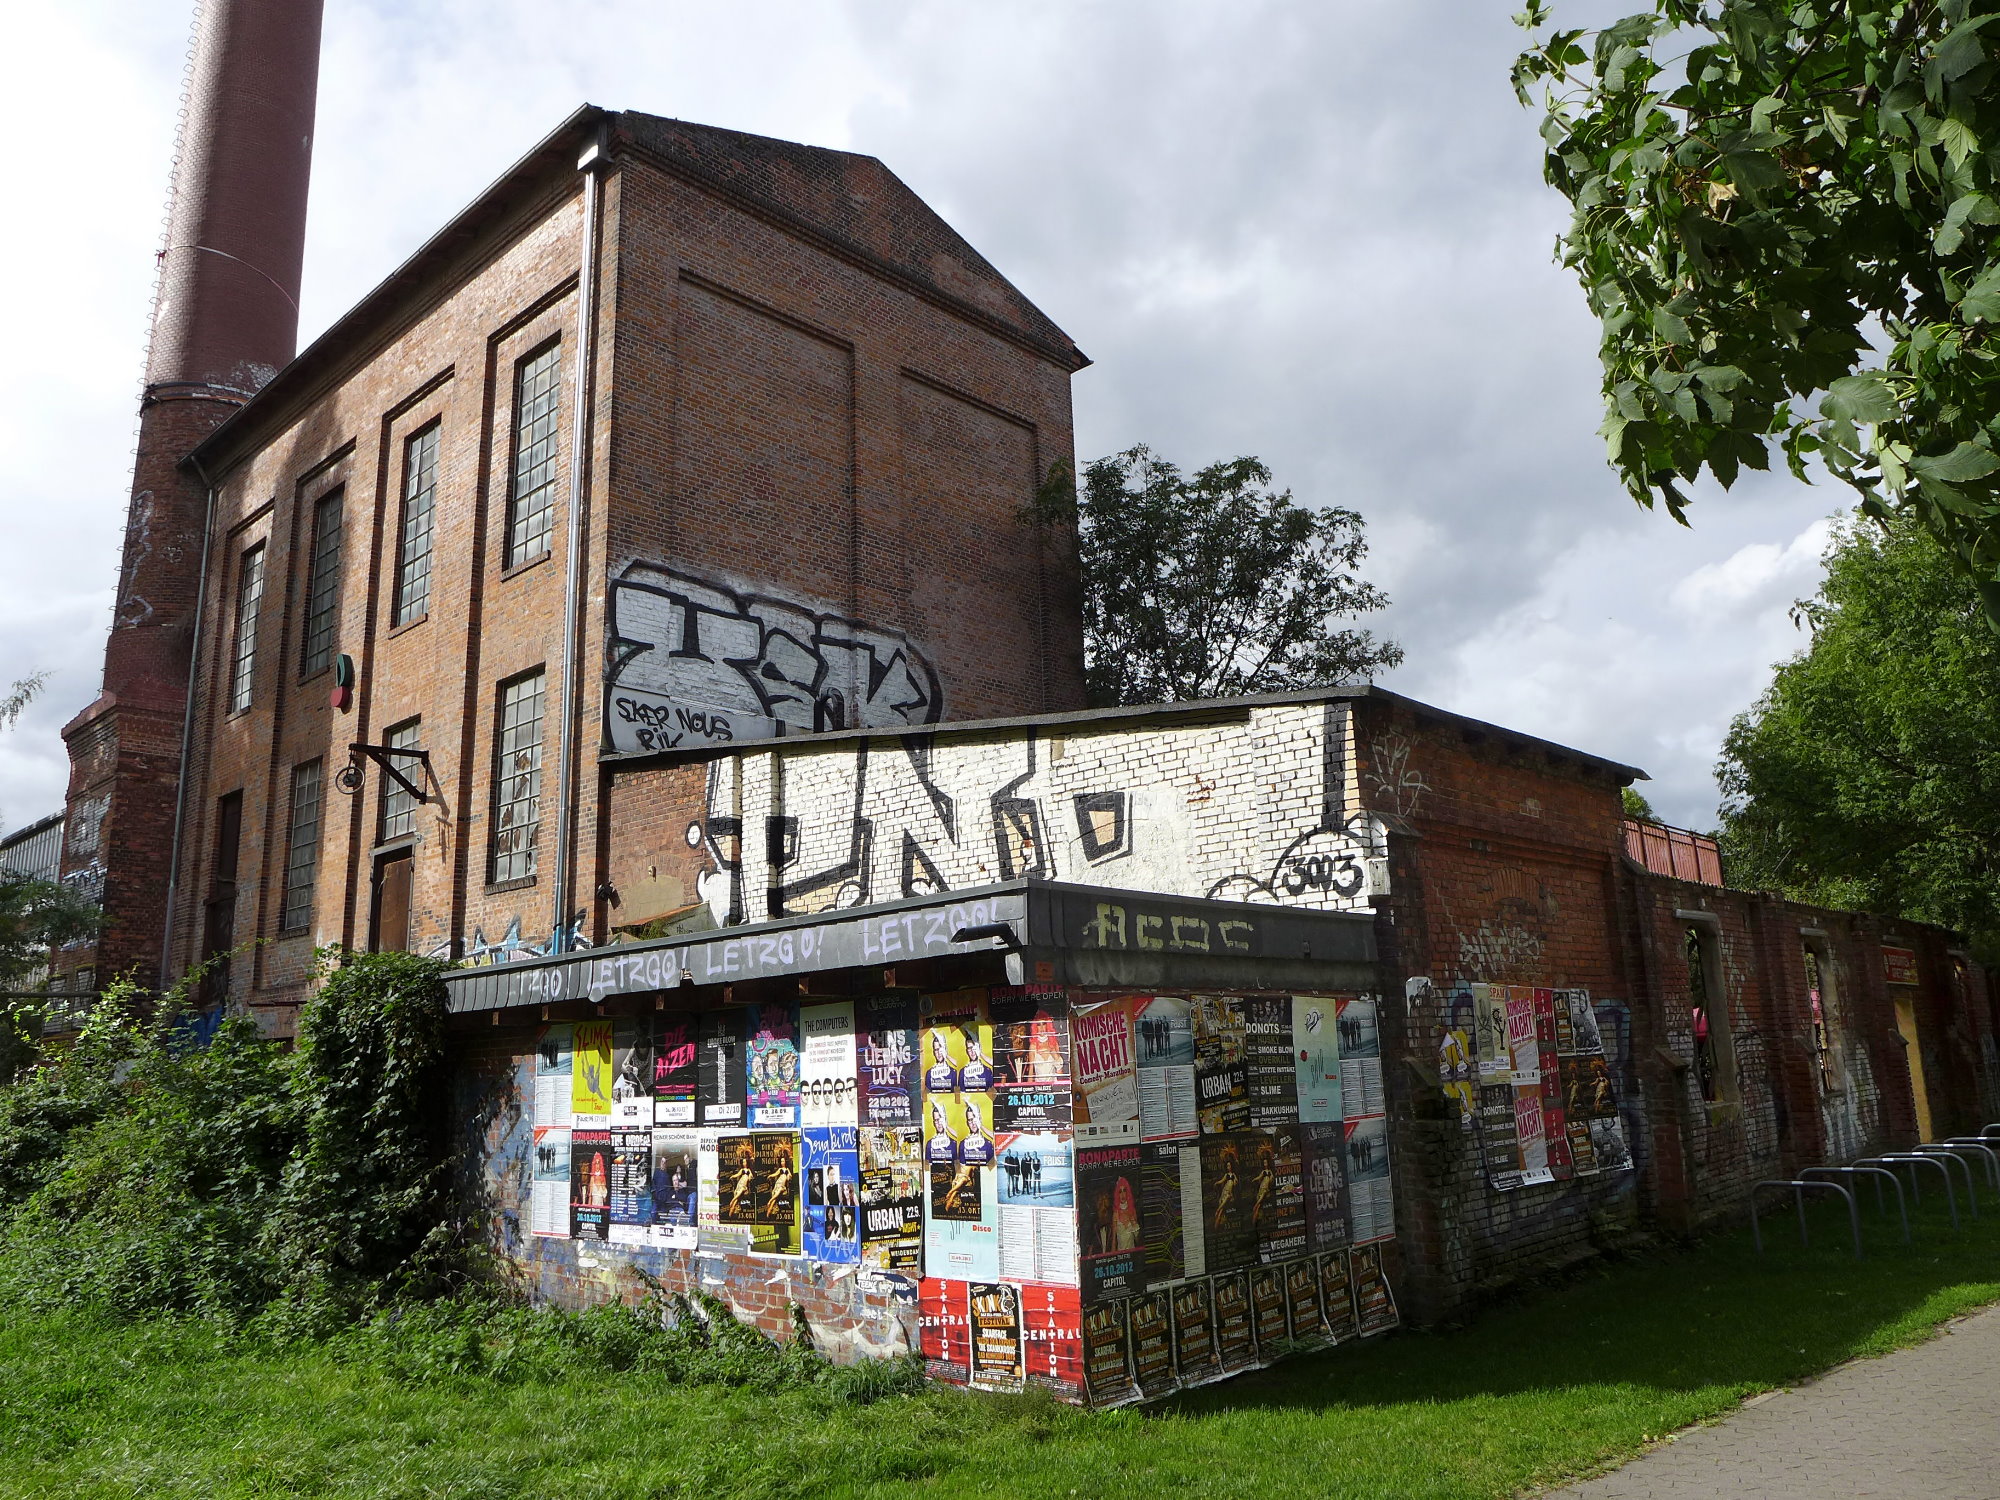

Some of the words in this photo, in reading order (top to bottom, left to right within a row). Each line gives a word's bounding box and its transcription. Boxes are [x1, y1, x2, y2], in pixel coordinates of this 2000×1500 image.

[991, 997, 1016, 1005] SORRY
[1042, 991, 1064, 1000] OPEN
[804, 1020, 815, 1032] THE
[816, 1016, 849, 1031] COMPUTERS
[1073, 1010, 1127, 1042] KOMISCHE
[1246, 1022, 1280, 1034] DONOTS
[1508, 1013, 1533, 1040] NACHT
[576, 1022, 612, 1057] SLIME
[1077, 1033, 1129, 1077] NACHT
[1258, 1046, 1278, 1054] SMOKE
[1258, 1055, 1290, 1065] OVERKILL
[872, 1066, 904, 1085] LUCY
[1080, 1068, 1131, 1085] Comedy-Marathon
[1260, 1075, 1296, 1085] LEVELLERS
[1201, 1072, 1232, 1098] URBAN
[1261, 1085, 1281, 1096] SLIME
[868, 1097, 879, 1107] 22
[1008, 1094, 1055, 1106] 26.10.2012
[725, 1105, 739, 1114] 2/10
[905, 1108, 911, 1116] 5
[1018, 1107, 1045, 1116] CAPITOL
[1261, 1106, 1298, 1116] BAKKUSHAN
[572, 1132, 610, 1140] BONAPARTE
[611, 1135, 623, 1146] THE
[1079, 1148, 1141, 1164] BONAPARTE
[1158, 1144, 1177, 1156] salon
[1078, 1162, 1102, 1172] SORRY
[1124, 1158, 1141, 1167] OPEN
[867, 1207, 903, 1232] URBAN
[972, 1224, 992, 1233] Disco
[1094, 1263, 1134, 1279] 26.10.2012
[1103, 1276, 1126, 1288] CAPITOL
[979, 1317, 1010, 1326] FESTIVAL
[1023, 1328, 1081, 1341] CENTRAL
